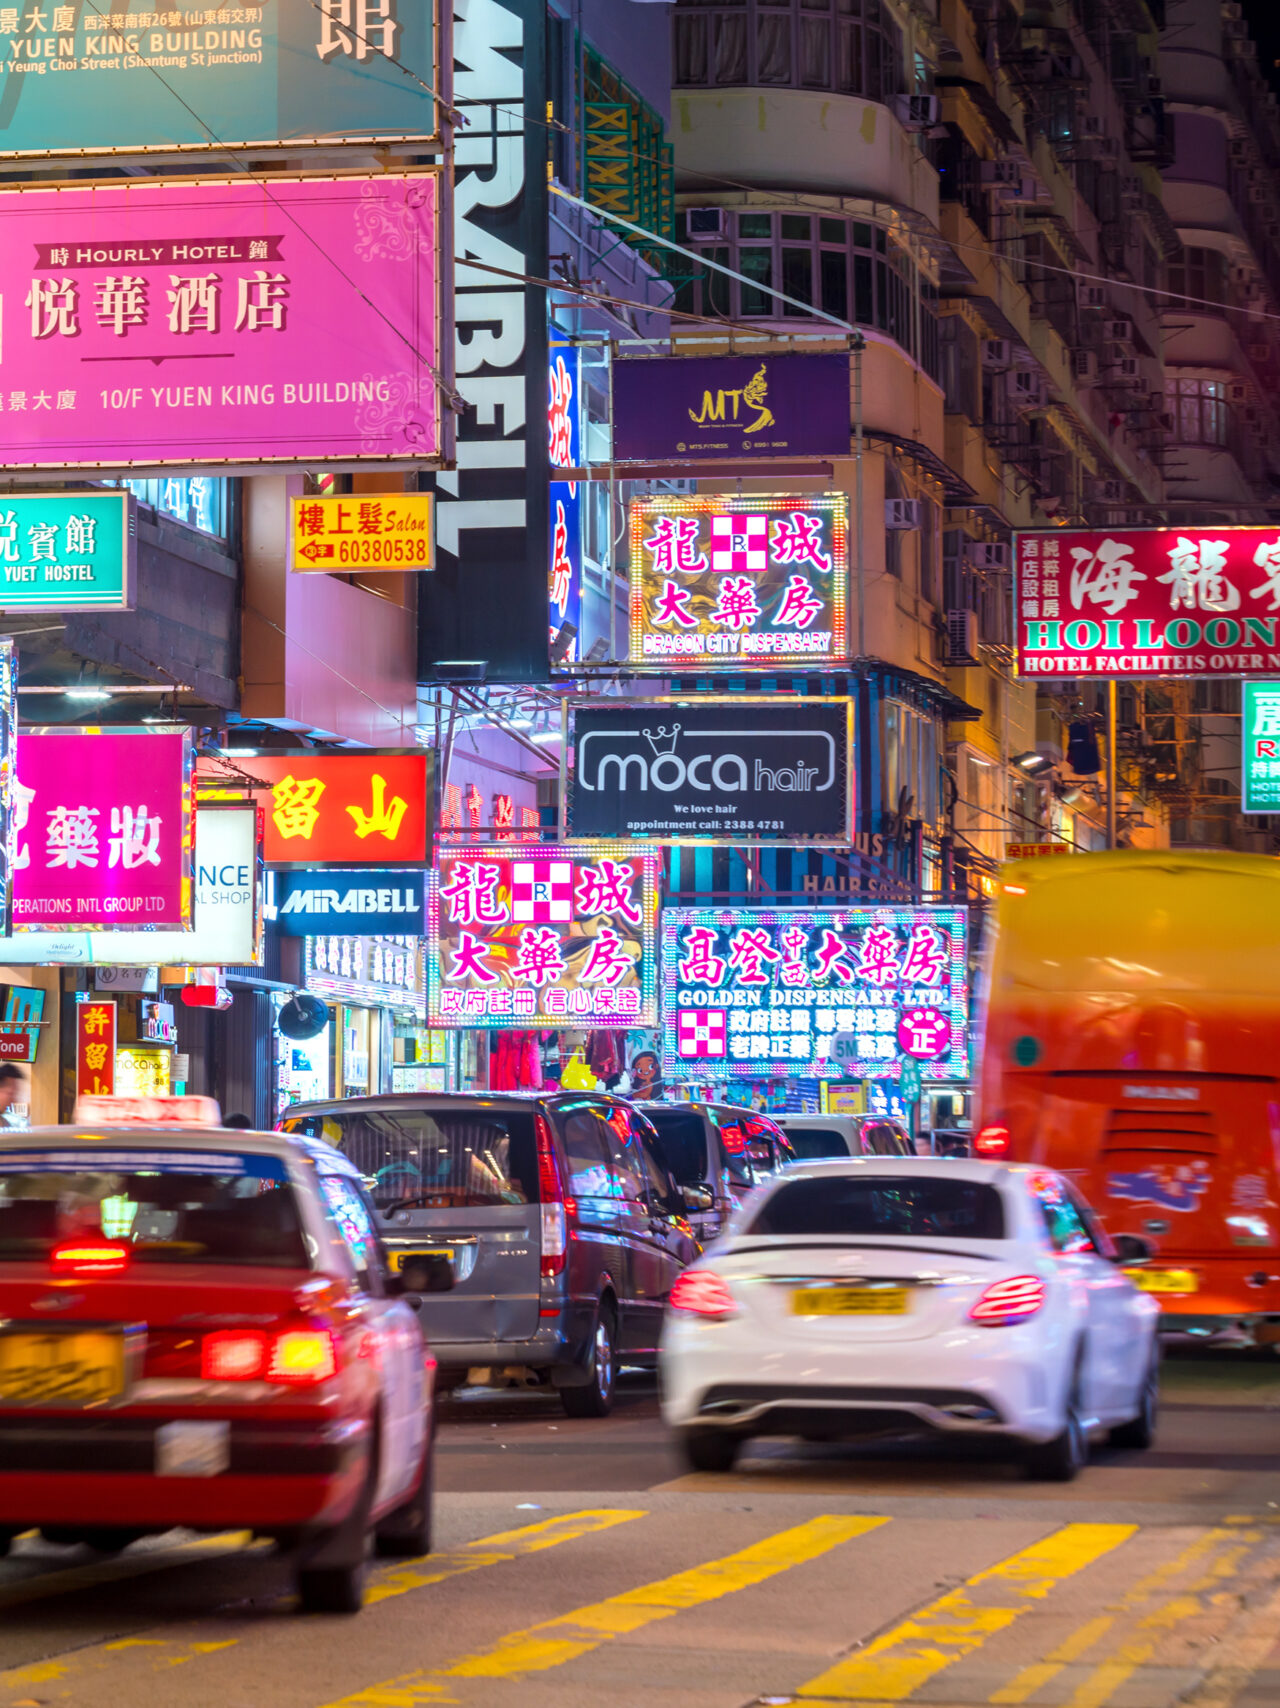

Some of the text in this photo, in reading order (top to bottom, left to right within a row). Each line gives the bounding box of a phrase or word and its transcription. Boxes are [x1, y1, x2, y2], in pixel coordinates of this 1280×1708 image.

[10, 38, 75, 58] YUEN
[86, 34, 140, 55] KING
[149, 28, 263, 53] BUILDING
[7, 59, 46, 76] Yeung
[49, 57, 78, 71] Choi
[80, 56, 120, 70] Street
[123, 53, 187, 70] (Shantung
[190, 52, 206, 66] St
[207, 50, 263, 67] junction)
[50, 240, 269, 266] 時 HOURLY HOTEL 鐘
[100, 386, 143, 409] 10/F
[150, 385, 213, 408] YUEN
[221, 383, 275, 406] KING
[283, 380, 390, 405] BUILDING
[298, 503, 427, 536] 樓上髮 Salon
[339, 539, 427, 563] 60380538
[644, 516, 709, 574] 龍
[772, 512, 832, 573] 城
[4, 566, 38, 582] YUET
[45, 564, 95, 581] HOSTEL
[652, 576, 825, 629] 大藥房
[643, 631, 832, 654] DRAGON CITY DISPENSARY
[1024, 616, 1279, 650] HOI LOON
[1024, 656, 1092, 672] HOTEL
[1209, 653, 1266, 670] OVER
[598, 753, 820, 791] moca hair
[673, 804, 738, 814] We love hair
[627, 820, 697, 831] appointment
[698, 819, 722, 830] call:
[757, 819, 785, 830] 4781
[76, 898, 102, 912] INTL
[104, 897, 143, 912] GROUP
[145, 896, 166, 911] LTD
[211, 890, 251, 904] SHOP
[280, 887, 420, 913] MIRABELL
[440, 861, 510, 925] 龍
[576, 858, 643, 925] 城
[446, 928, 637, 986] 大藥房
[441, 987, 642, 1015] 政府註冊 信心保證
[678, 988, 949, 1006] GOLDEN DISPENSARY LTD.
[909, 1027, 937, 1054] 正
